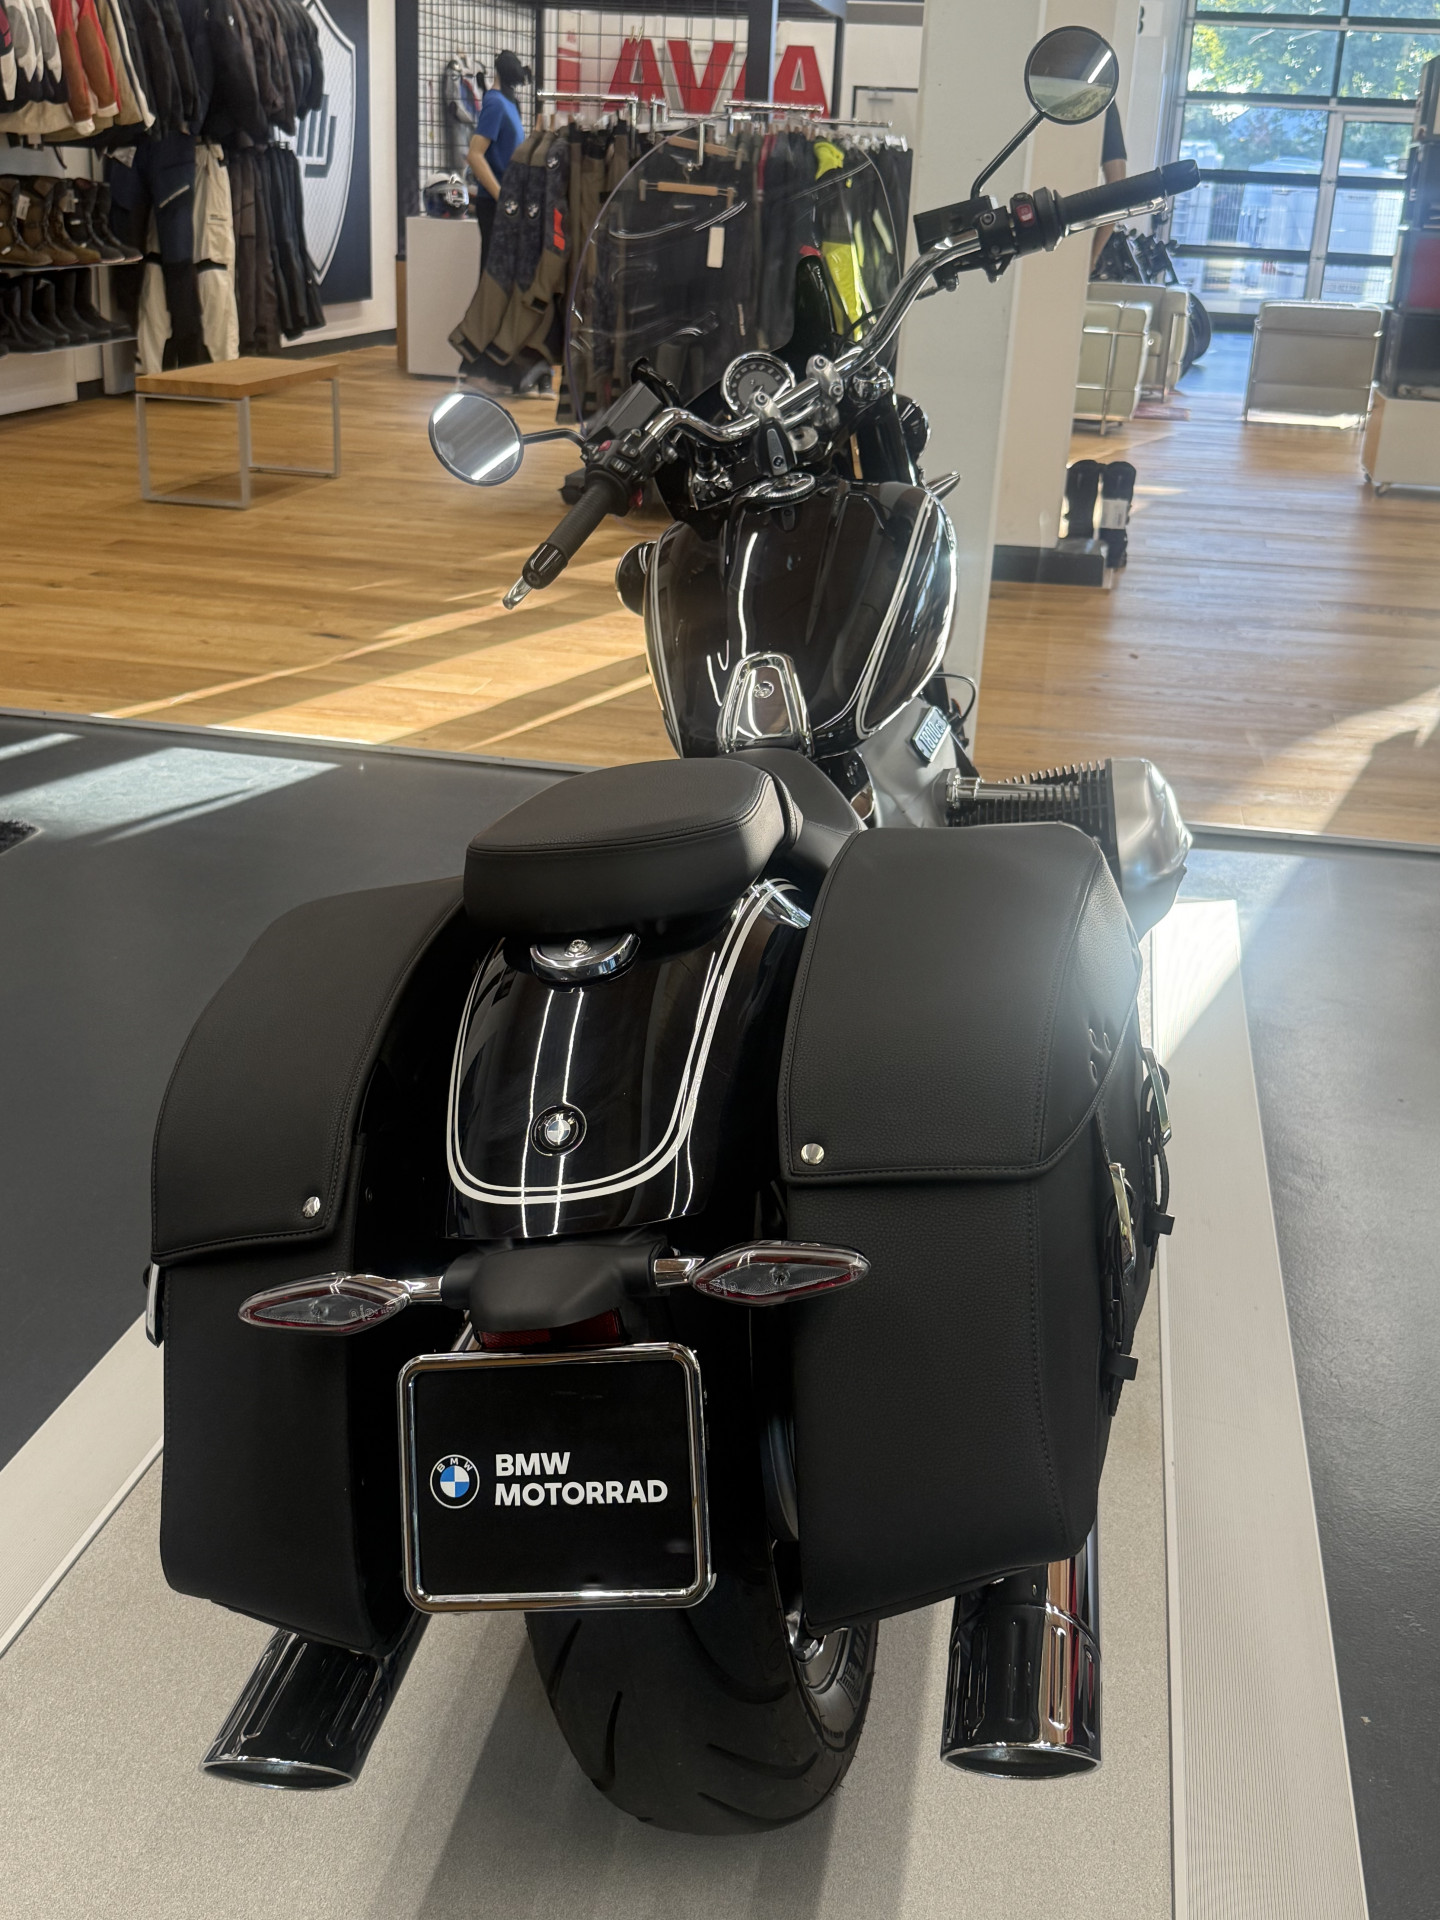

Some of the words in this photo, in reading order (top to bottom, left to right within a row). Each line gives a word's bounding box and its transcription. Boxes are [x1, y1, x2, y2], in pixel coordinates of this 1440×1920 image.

[436, 1457, 473, 1473] BMW
[495, 1451, 571, 1477] BMW
[494, 1479, 669, 1507] MOTORRAD
